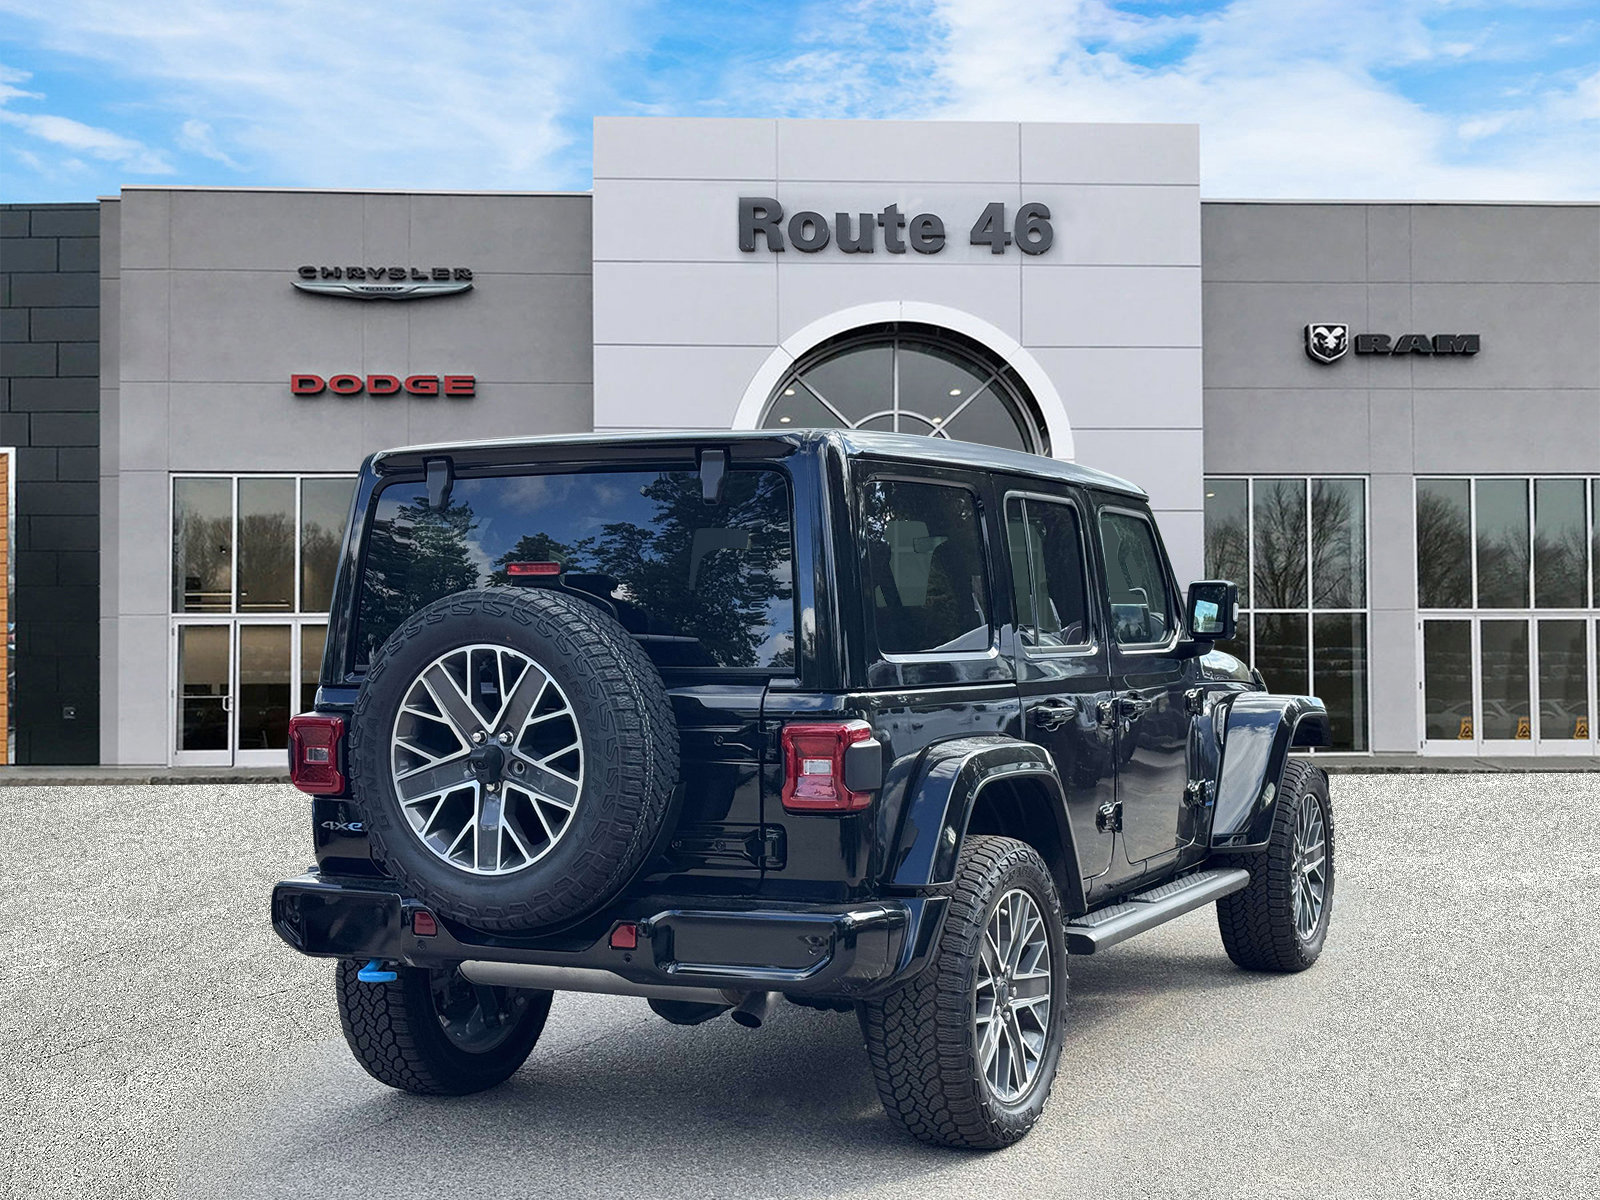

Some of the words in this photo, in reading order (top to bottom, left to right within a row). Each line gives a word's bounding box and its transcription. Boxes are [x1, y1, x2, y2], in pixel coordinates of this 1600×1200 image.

[738, 196, 947, 255] Route
[969, 202, 1054, 255] 46
[297, 265, 474, 281] CHRYSLER
[1354, 333, 1481, 356] RAM
[290, 374, 476, 396] DODGE
